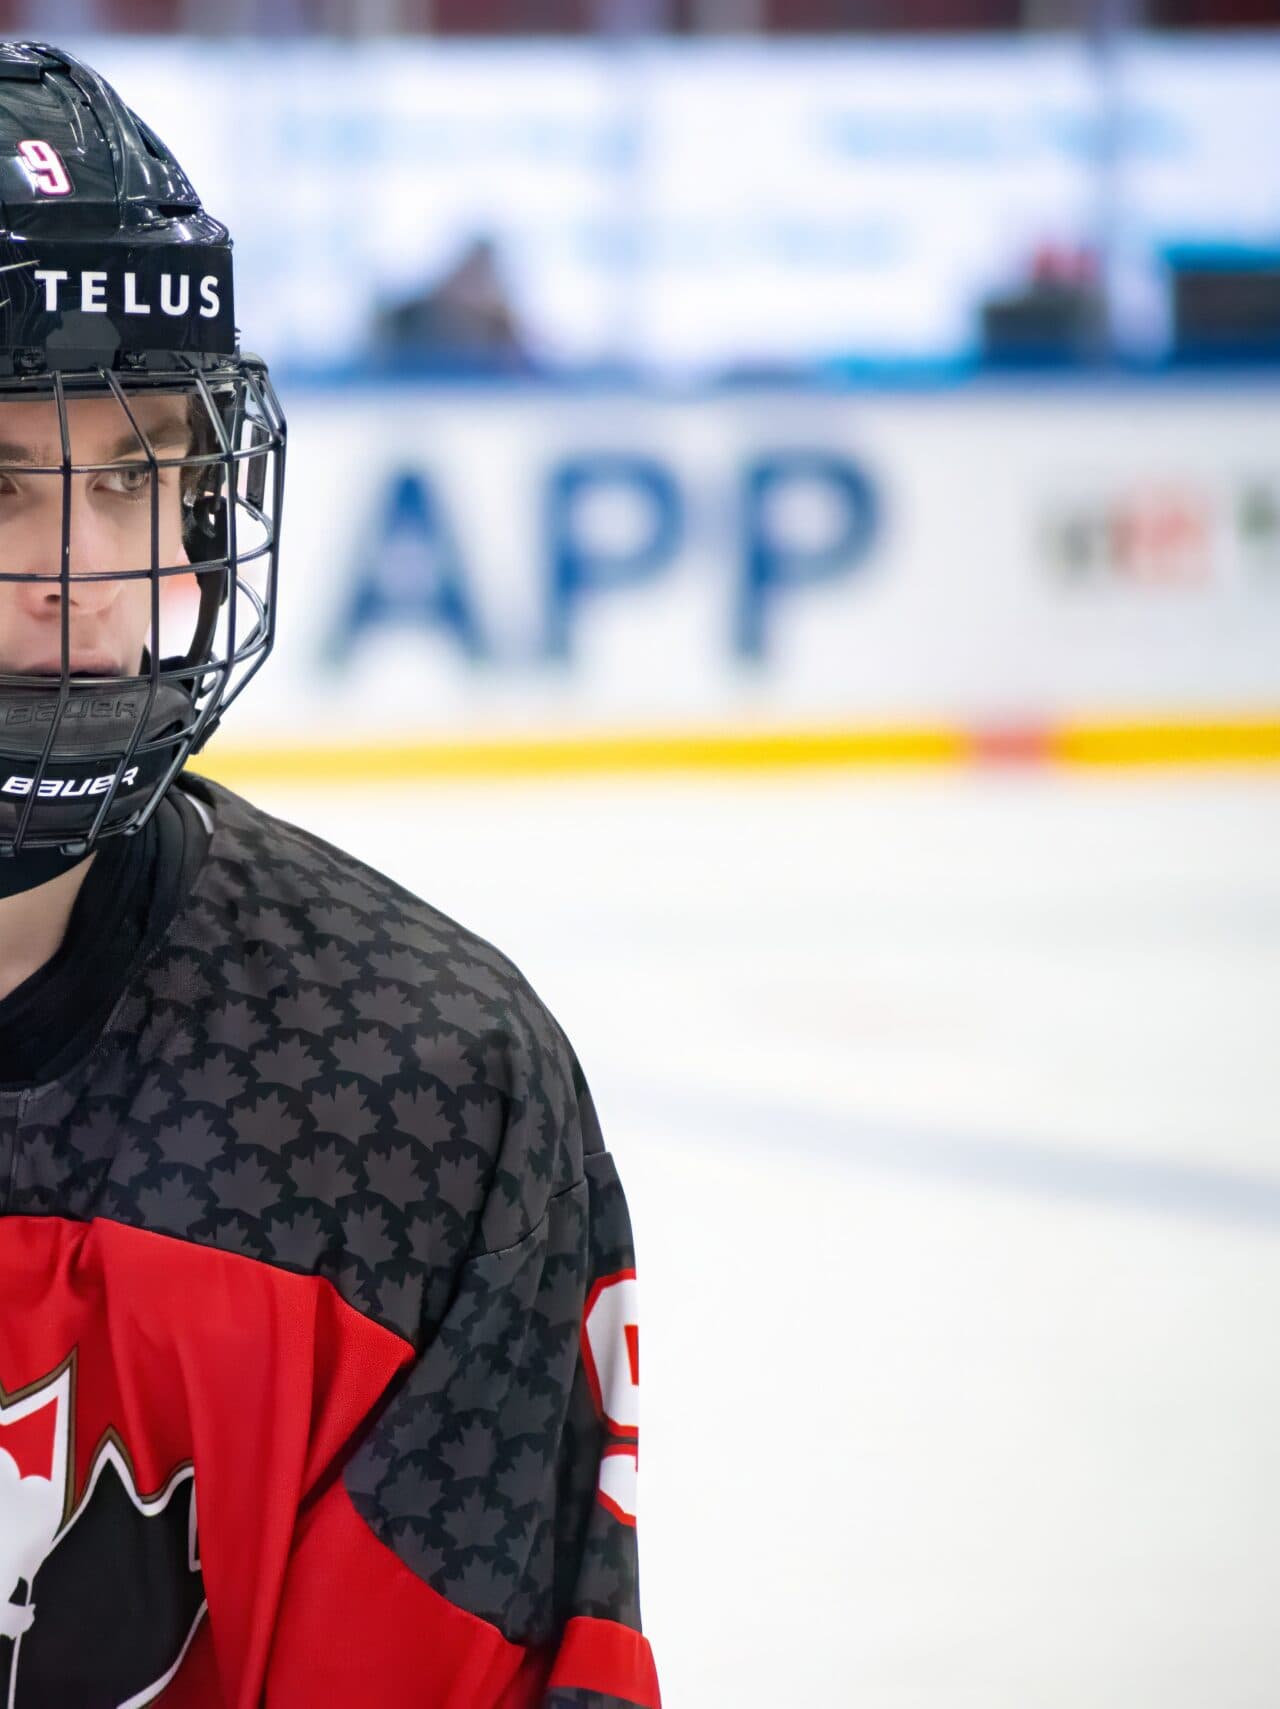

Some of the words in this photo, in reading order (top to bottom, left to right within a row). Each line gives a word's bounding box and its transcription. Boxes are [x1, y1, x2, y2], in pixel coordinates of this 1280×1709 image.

[18, 140, 72, 195] 9
[37, 270, 220, 317] TELUS
[318, 450, 886, 668] APP
